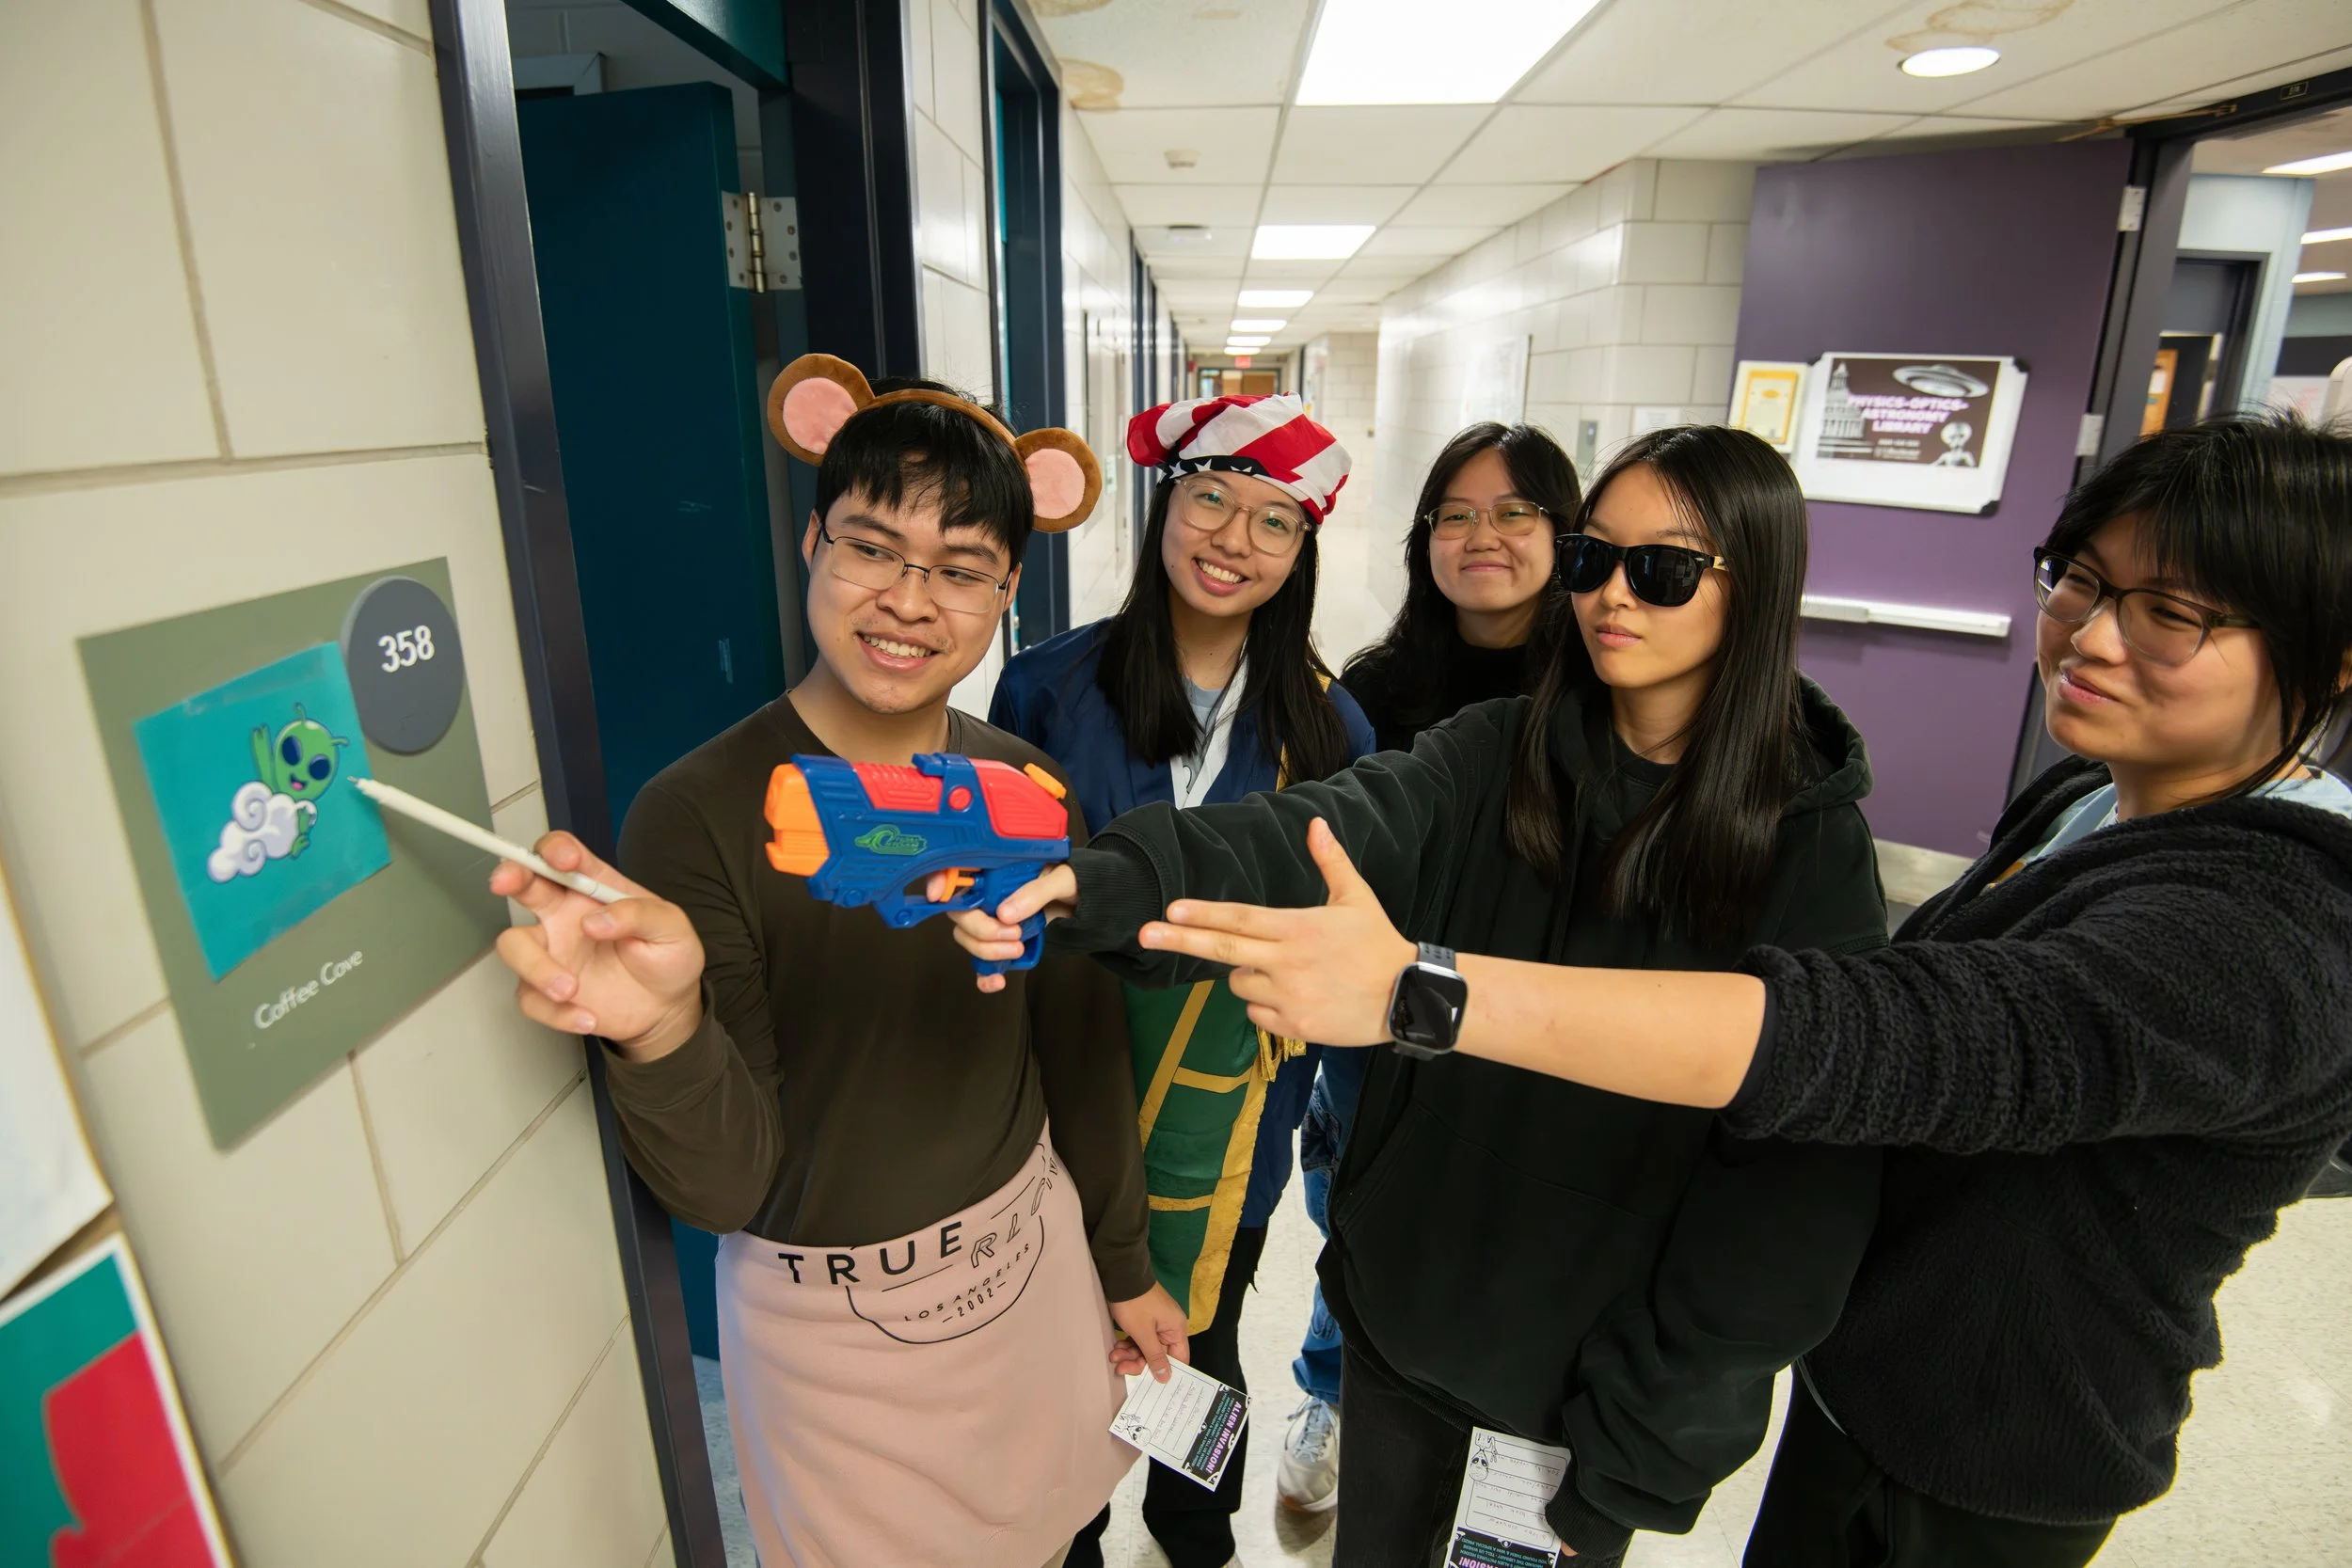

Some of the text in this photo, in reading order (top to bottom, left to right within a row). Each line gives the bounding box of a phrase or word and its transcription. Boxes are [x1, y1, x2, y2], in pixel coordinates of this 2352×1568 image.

[1862, 407, 1950, 422] ASTRONOMY
[1871, 420, 1933, 434] LIBRARY
[378, 625, 435, 673] 358
[254, 950, 363, 1029] Coffee Cove
[778, 1222, 962, 1287] TRUE
[904, 1243, 1029, 1322] LOS ANGELES
[1204, 1401, 1242, 1473] ALIEN INVASION!
[1477, 1554, 1497, 1563] PICTURES
[1497, 1554, 1515, 1562] LIBRARY
